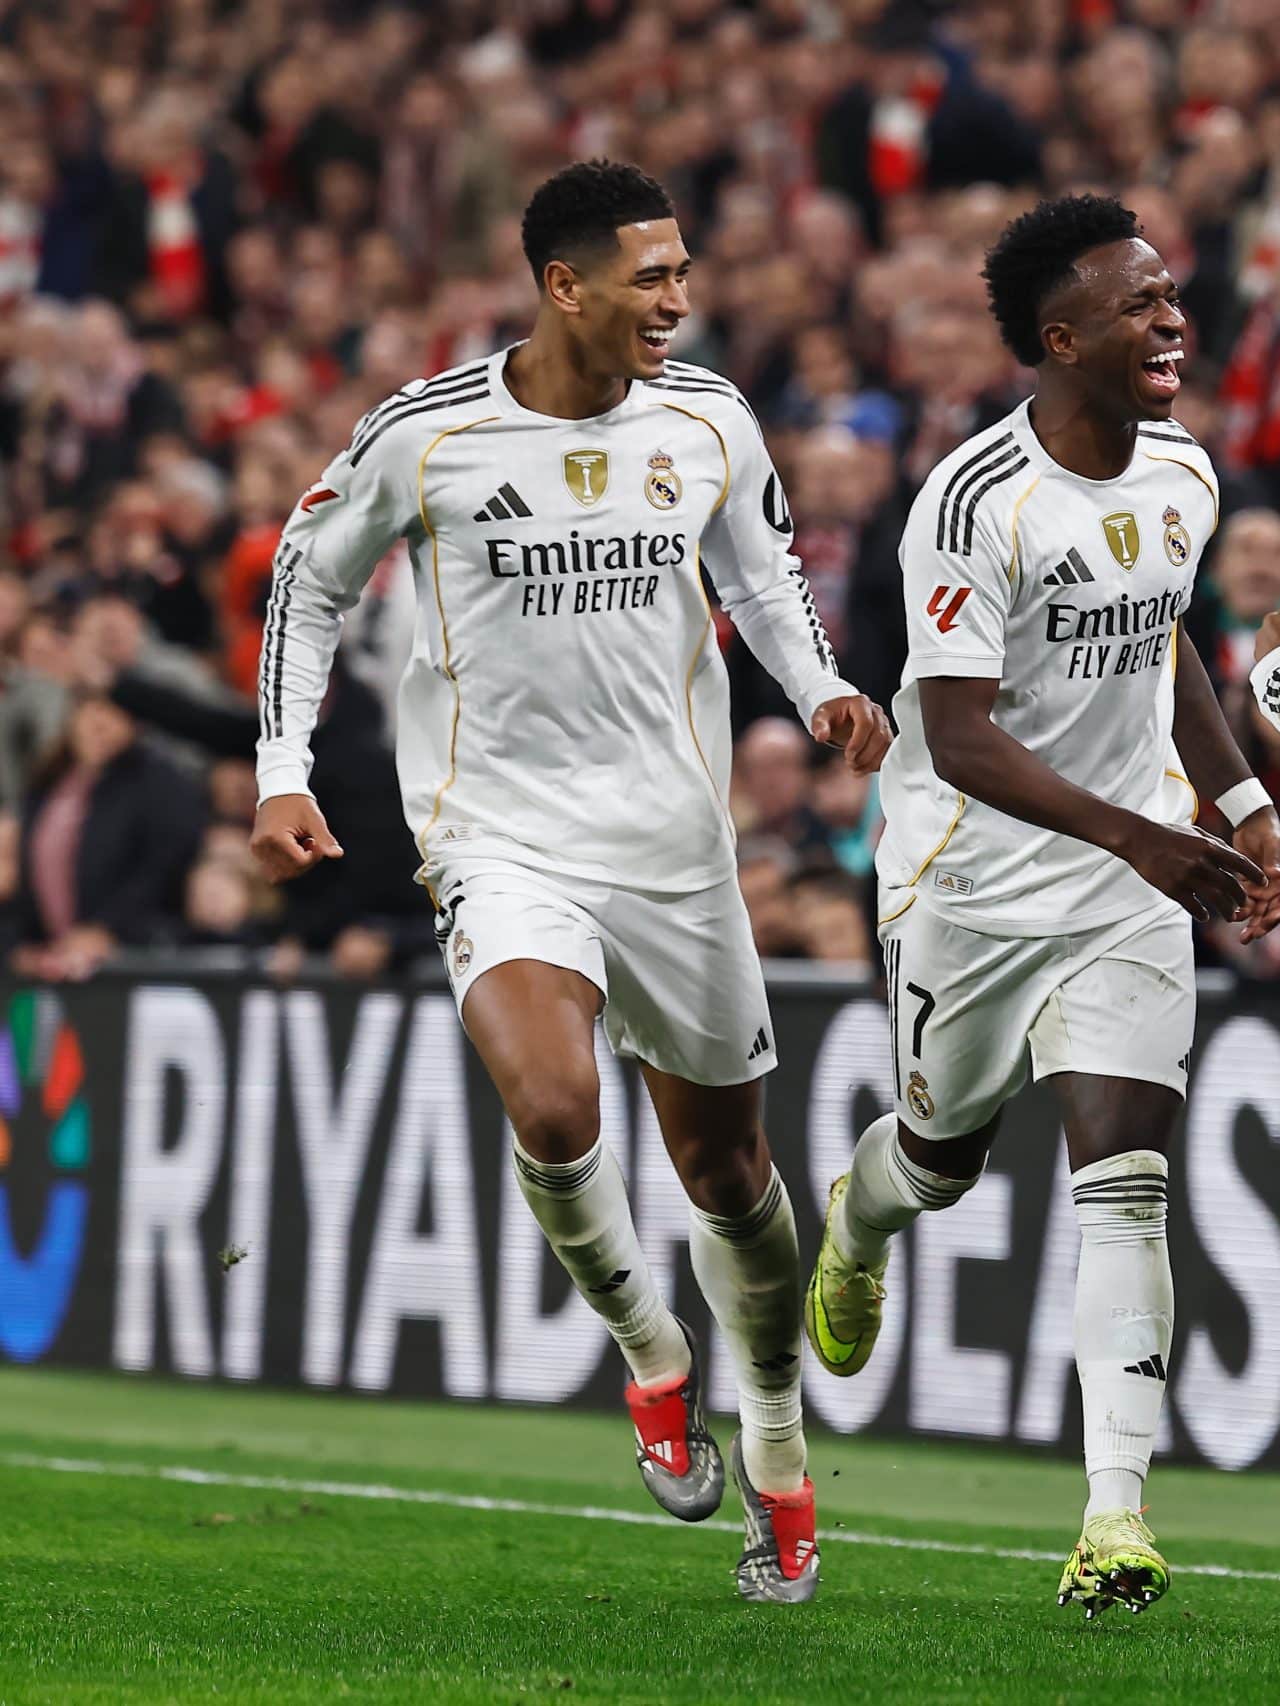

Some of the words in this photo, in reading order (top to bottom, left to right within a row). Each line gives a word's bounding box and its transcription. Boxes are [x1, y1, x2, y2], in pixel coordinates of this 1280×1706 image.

[485, 530, 686, 578] Emirates
[522, 583, 564, 616] FLY
[574, 575, 659, 614] BETTER
[1046, 587, 1186, 642] Emirate
[1068, 645, 1110, 679] FLY
[1114, 632, 1171, 675] BETTE
[906, 981, 936, 1060] 7
